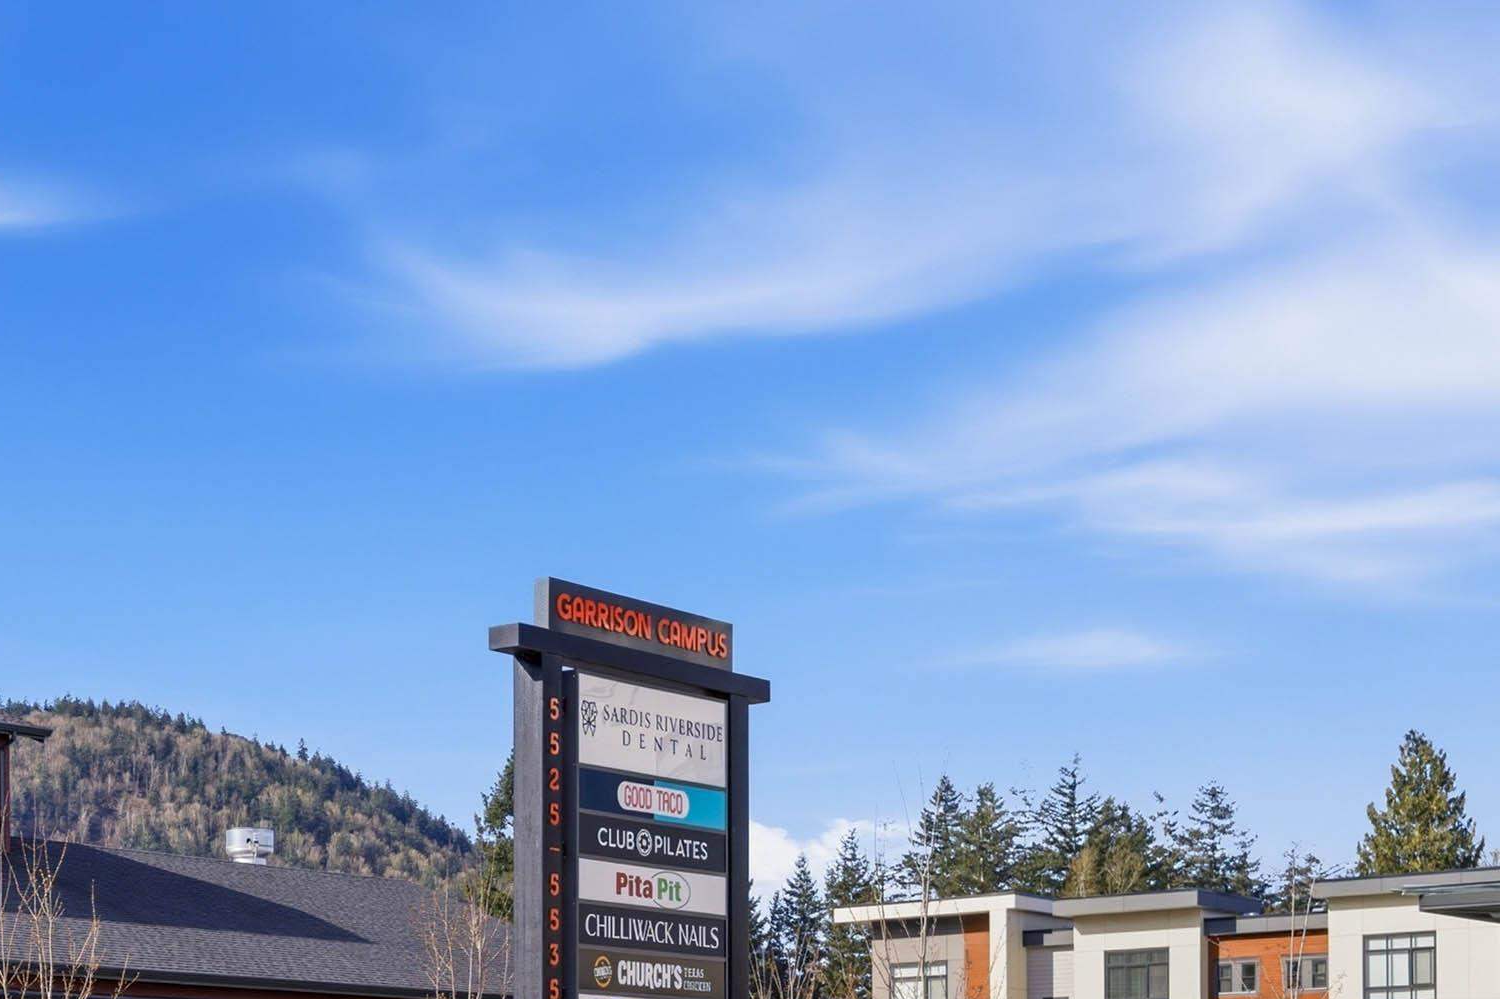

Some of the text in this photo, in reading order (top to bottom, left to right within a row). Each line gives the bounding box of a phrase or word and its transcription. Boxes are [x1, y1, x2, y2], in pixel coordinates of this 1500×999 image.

[557, 592, 727, 659] GARRISON CAMPUS
[603, 704, 723, 742] SARDIS RIVERSIDE
[622, 730, 707, 760] DENTAL
[624, 785, 683, 815] GOOD TACO
[597, 827, 708, 860] CLUB PILATES
[616, 872, 682, 902] Pita Pit
[585, 913, 720, 949] CHILLIWACK NAILS
[617, 960, 683, 990] CHURCH'S
